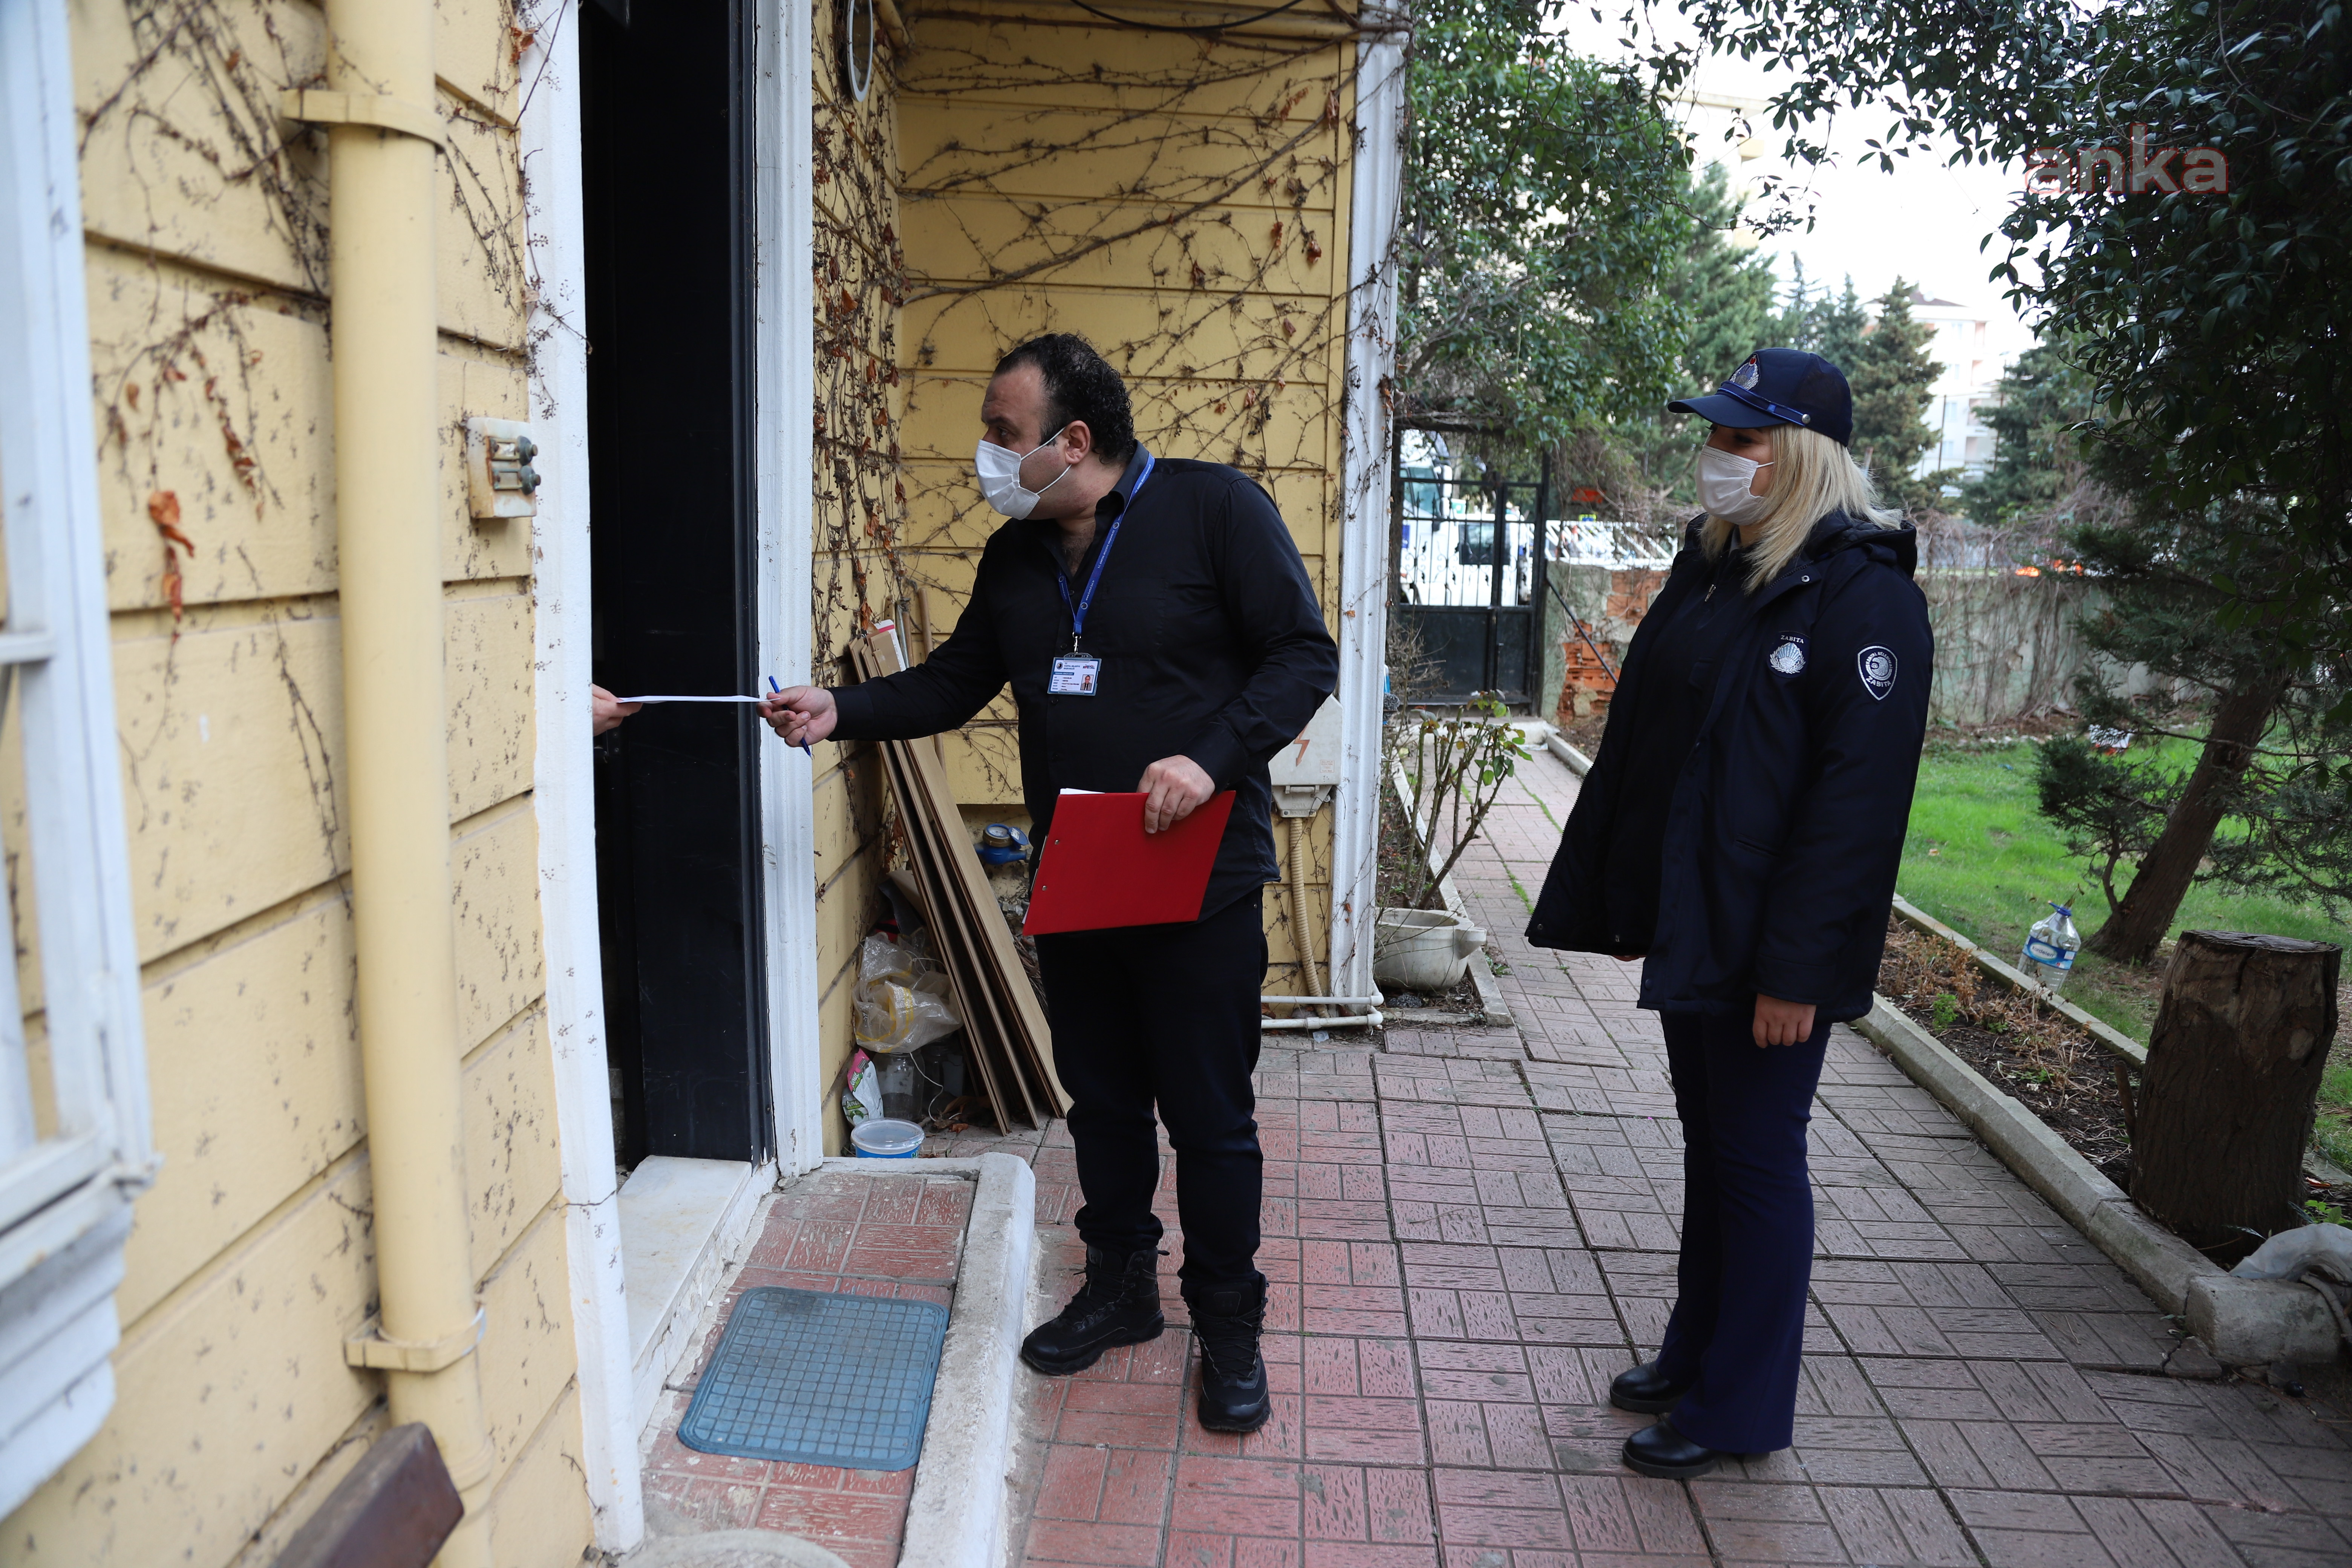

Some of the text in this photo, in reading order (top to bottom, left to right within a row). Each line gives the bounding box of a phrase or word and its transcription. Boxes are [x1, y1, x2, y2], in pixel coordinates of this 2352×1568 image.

[1781, 635, 1804, 644] ZABITA
[1865, 652, 1878, 665] KARTAL
[1865, 676, 1891, 687] ZABITA
